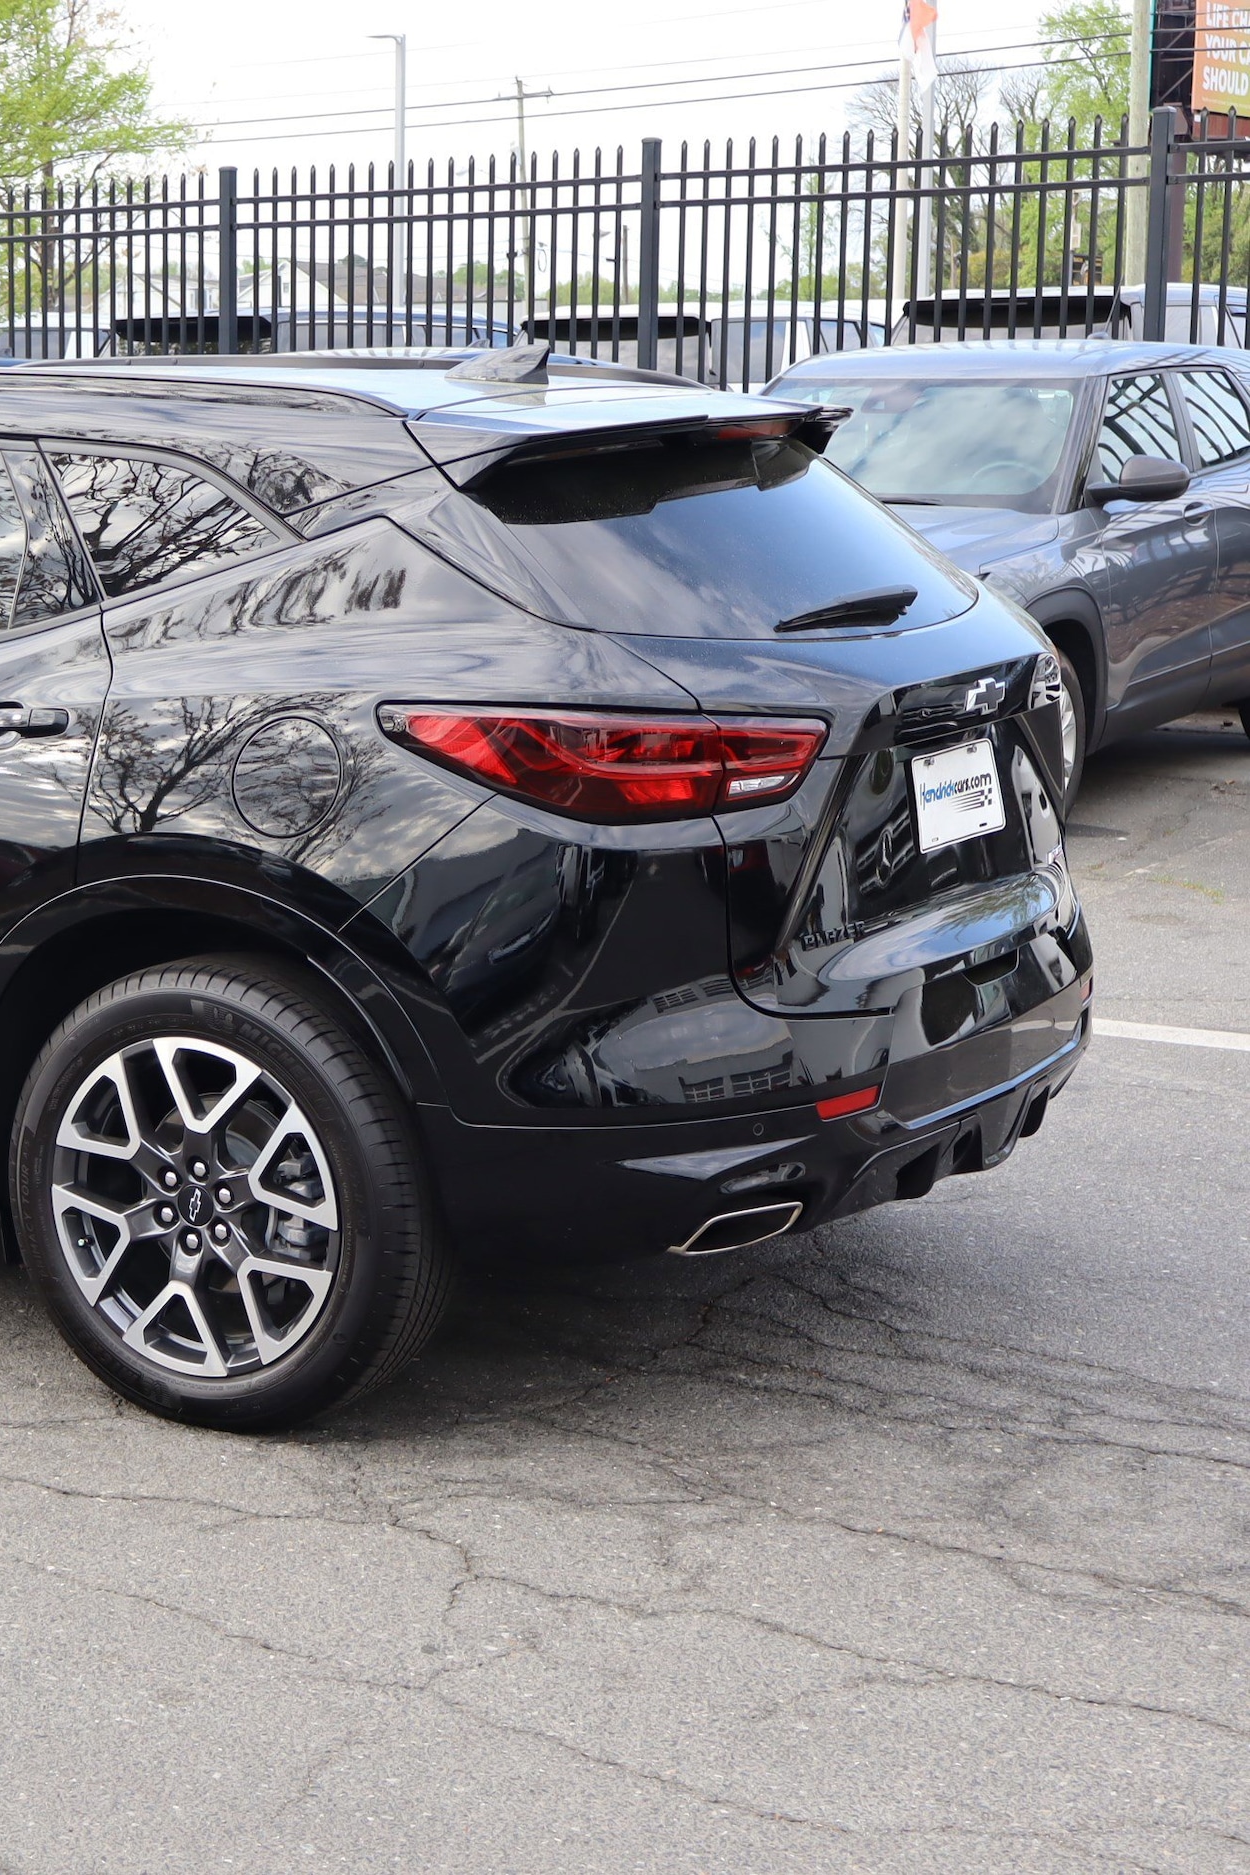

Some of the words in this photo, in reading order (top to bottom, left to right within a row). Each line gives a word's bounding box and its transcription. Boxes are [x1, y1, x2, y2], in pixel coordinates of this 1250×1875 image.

[1206, 1, 1231, 29] LIFE
[1205, 33, 1237, 63] YOUR
[1202, 65, 1249, 96] SHOULD
[919, 772, 992, 811] Hendrickcars.com
[801, 920, 866, 951] BLAZER
[21, 1164, 31, 1204] TOUR
